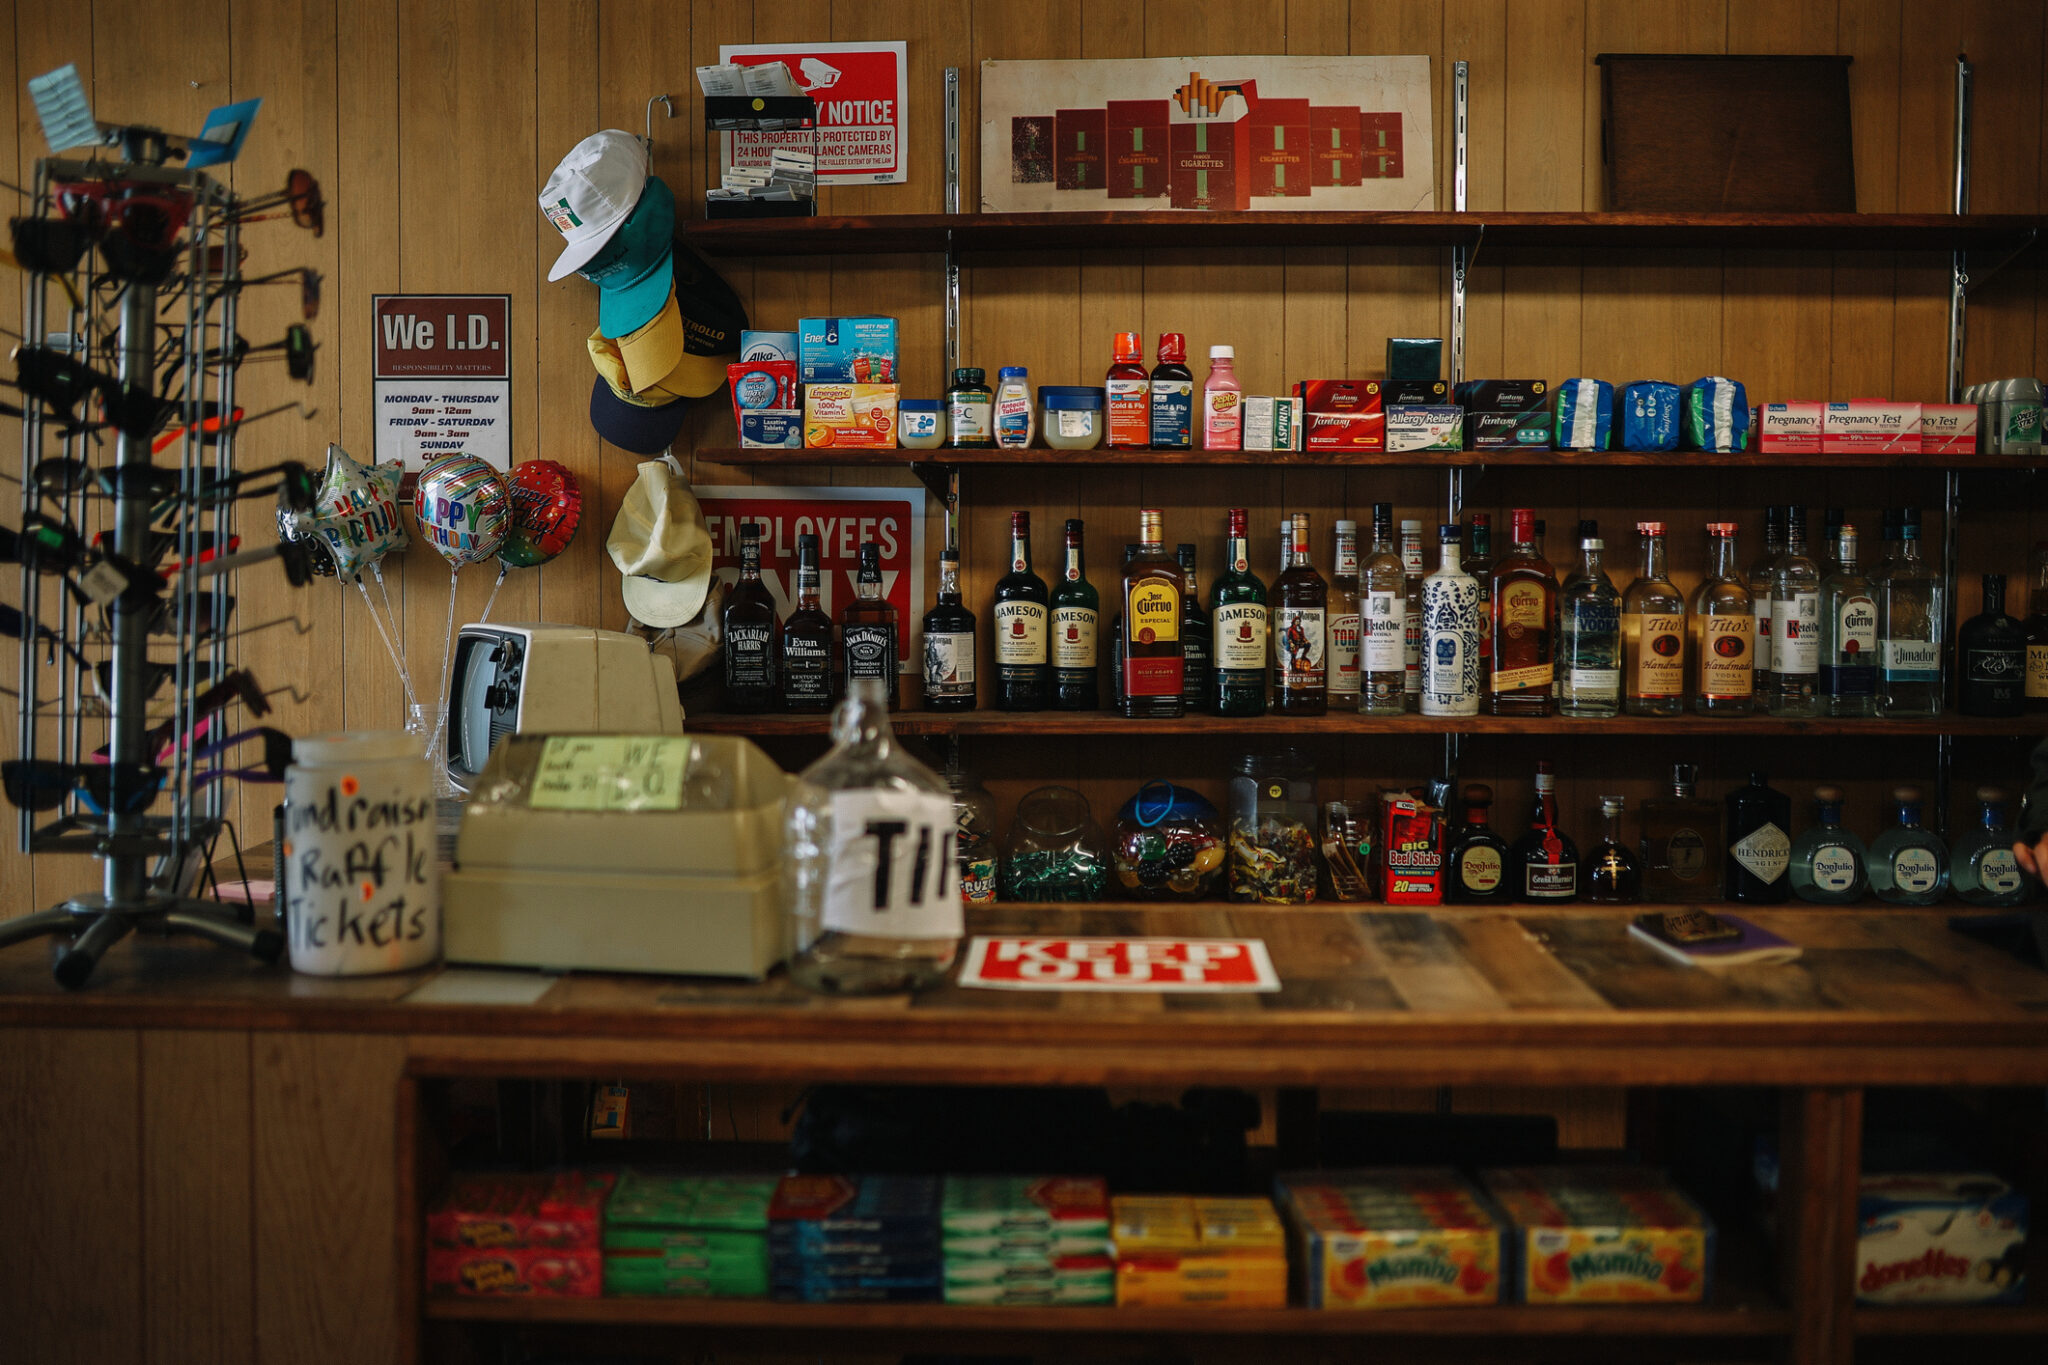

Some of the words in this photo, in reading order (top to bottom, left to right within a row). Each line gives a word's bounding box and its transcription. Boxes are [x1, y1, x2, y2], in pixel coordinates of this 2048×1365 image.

[828, 100, 893, 125] NOTICE
[737, 132, 758, 144] THIS
[762, 131, 809, 143] PROPERTY
[823, 130, 876, 142] PROTECTED
[880, 130, 892, 141] BY
[737, 146, 749, 158] 24
[848, 144, 892, 155] CAMERAS
[1118, 157, 1159, 165] CIGARETTES
[1180, 160, 1224, 168] CIGARETTES
[382, 314, 435, 350] We
[446, 314, 500, 350] I.D.
[392, 364, 454, 372] RESPONSIBILITY
[455, 364, 492, 372] MATTERS
[384, 395, 433, 404] MONDAY
[442, 395, 500, 404] THURSDAY
[1212, 394, 1236, 405] Pepto
[411, 406, 435, 415] 9am
[444, 406, 472, 415] 12am
[963, 407, 973, 418] C
[389, 418, 428, 427] FRIDAY
[437, 418, 495, 427] SATURDAY
[1278, 404, 1288, 444] ASPIRIN
[1311, 415, 1351, 429] fantasy
[1390, 414, 1425, 426] Allergy
[1425, 413, 1456, 424] Relief
[1477, 415, 1518, 428] fantasy
[1768, 416, 1815, 427] Pregnancy
[1828, 414, 1879, 426] Pregnancy
[1882, 414, 1902, 424] Test
[1938, 417, 1958, 425] Test
[414, 429, 438, 438] 9am
[446, 429, 470, 438] 3am
[420, 441, 464, 449] SUNDAY
[334, 477, 389, 517] HAPPY
[415, 487, 482, 532] HAPPY
[1148, 592, 1162, 601] Jose
[1510, 594, 1538, 608] Cuervo
[996, 606, 1043, 620] JAMESON
[1137, 598, 1172, 615] Cuervo
[1855, 608, 1866, 616] Jose
[1050, 612, 1096, 625] JAMESON
[1219, 608, 1266, 623] JAMESON
[1299, 610, 1320, 622] Morgan
[1845, 614, 1874, 628] Cuervo
[1388, 620, 1400, 631] One
[1648, 618, 1684, 632] Tito's
[1710, 618, 1749, 632] Tito's
[1787, 620, 1812, 638] Ketel
[728, 629, 770, 643] ZACKARIAH
[846, 634, 862, 648] JACK
[862, 631, 888, 648] DANIEL'S
[737, 641, 761, 651] HARRIS
[792, 638, 818, 648] Evan
[784, 647, 826, 656] Williams
[1896, 647, 1937, 664] Jimador
[1401, 841, 1430, 852] BIG
[1389, 850, 1412, 866] Beef
[1412, 850, 1441, 866] Sticks
[1393, 880, 1409, 892] 20
[289, 895, 426, 949] Tickets
[996, 940, 1241, 967] KEEP
[1018, 959, 1220, 983] OUT
[1366, 1256, 1460, 1288] Mamba
[1568, 1248, 1664, 1283] Mamba
